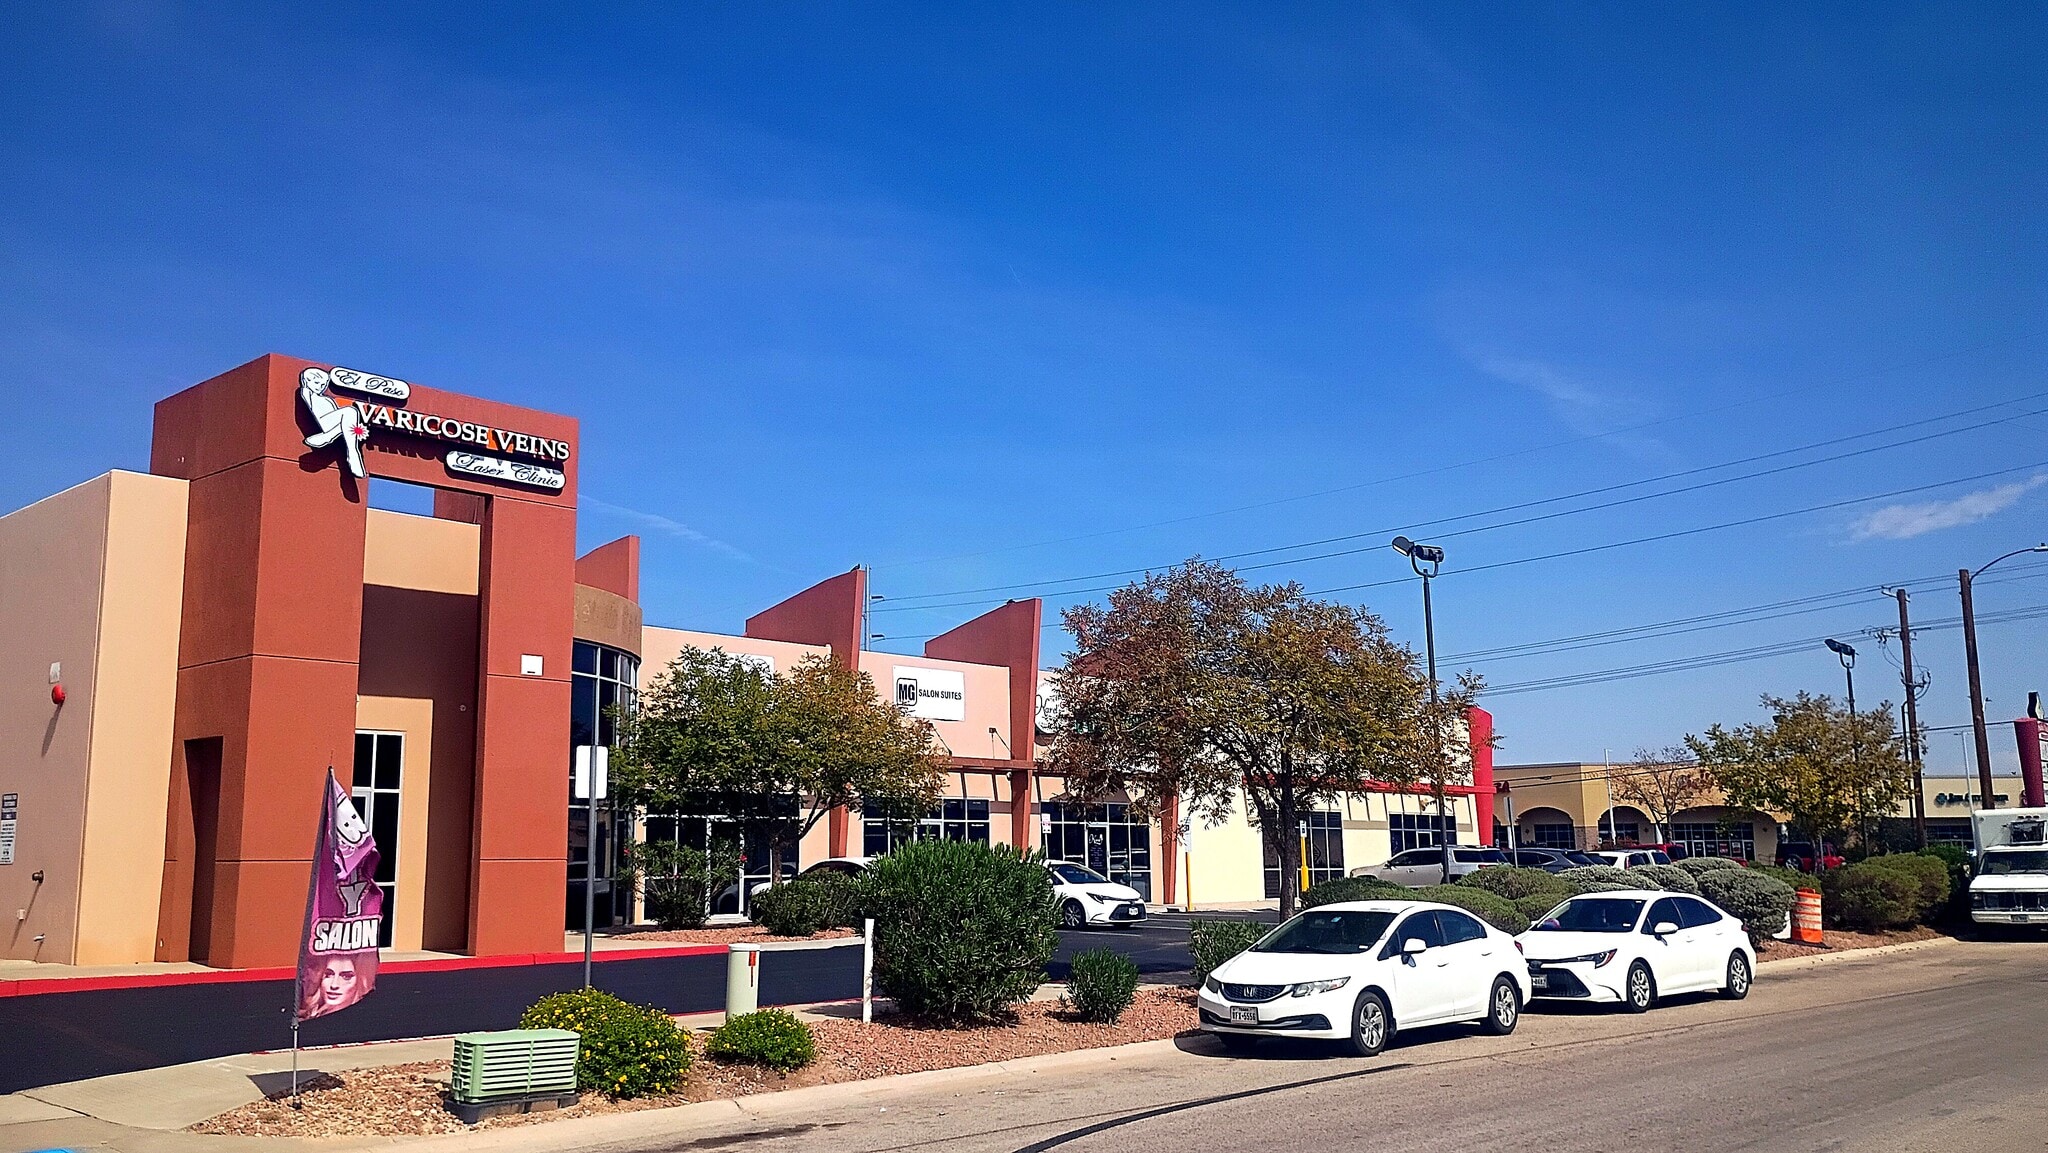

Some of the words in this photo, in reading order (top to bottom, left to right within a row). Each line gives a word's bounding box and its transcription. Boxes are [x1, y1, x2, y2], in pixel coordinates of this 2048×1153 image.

[334, 369, 361, 386] El
[365, 376, 405, 396] Paso
[355, 401, 490, 445] VARICOSE
[494, 428, 570, 460] VEINS
[452, 454, 505, 476] Laser
[510, 462, 559, 486] Clinic
[898, 683, 916, 702] MG
[918, 688, 940, 699] SALON
[940, 690, 962, 701] SUITES
[314, 919, 379, 951] SALON
